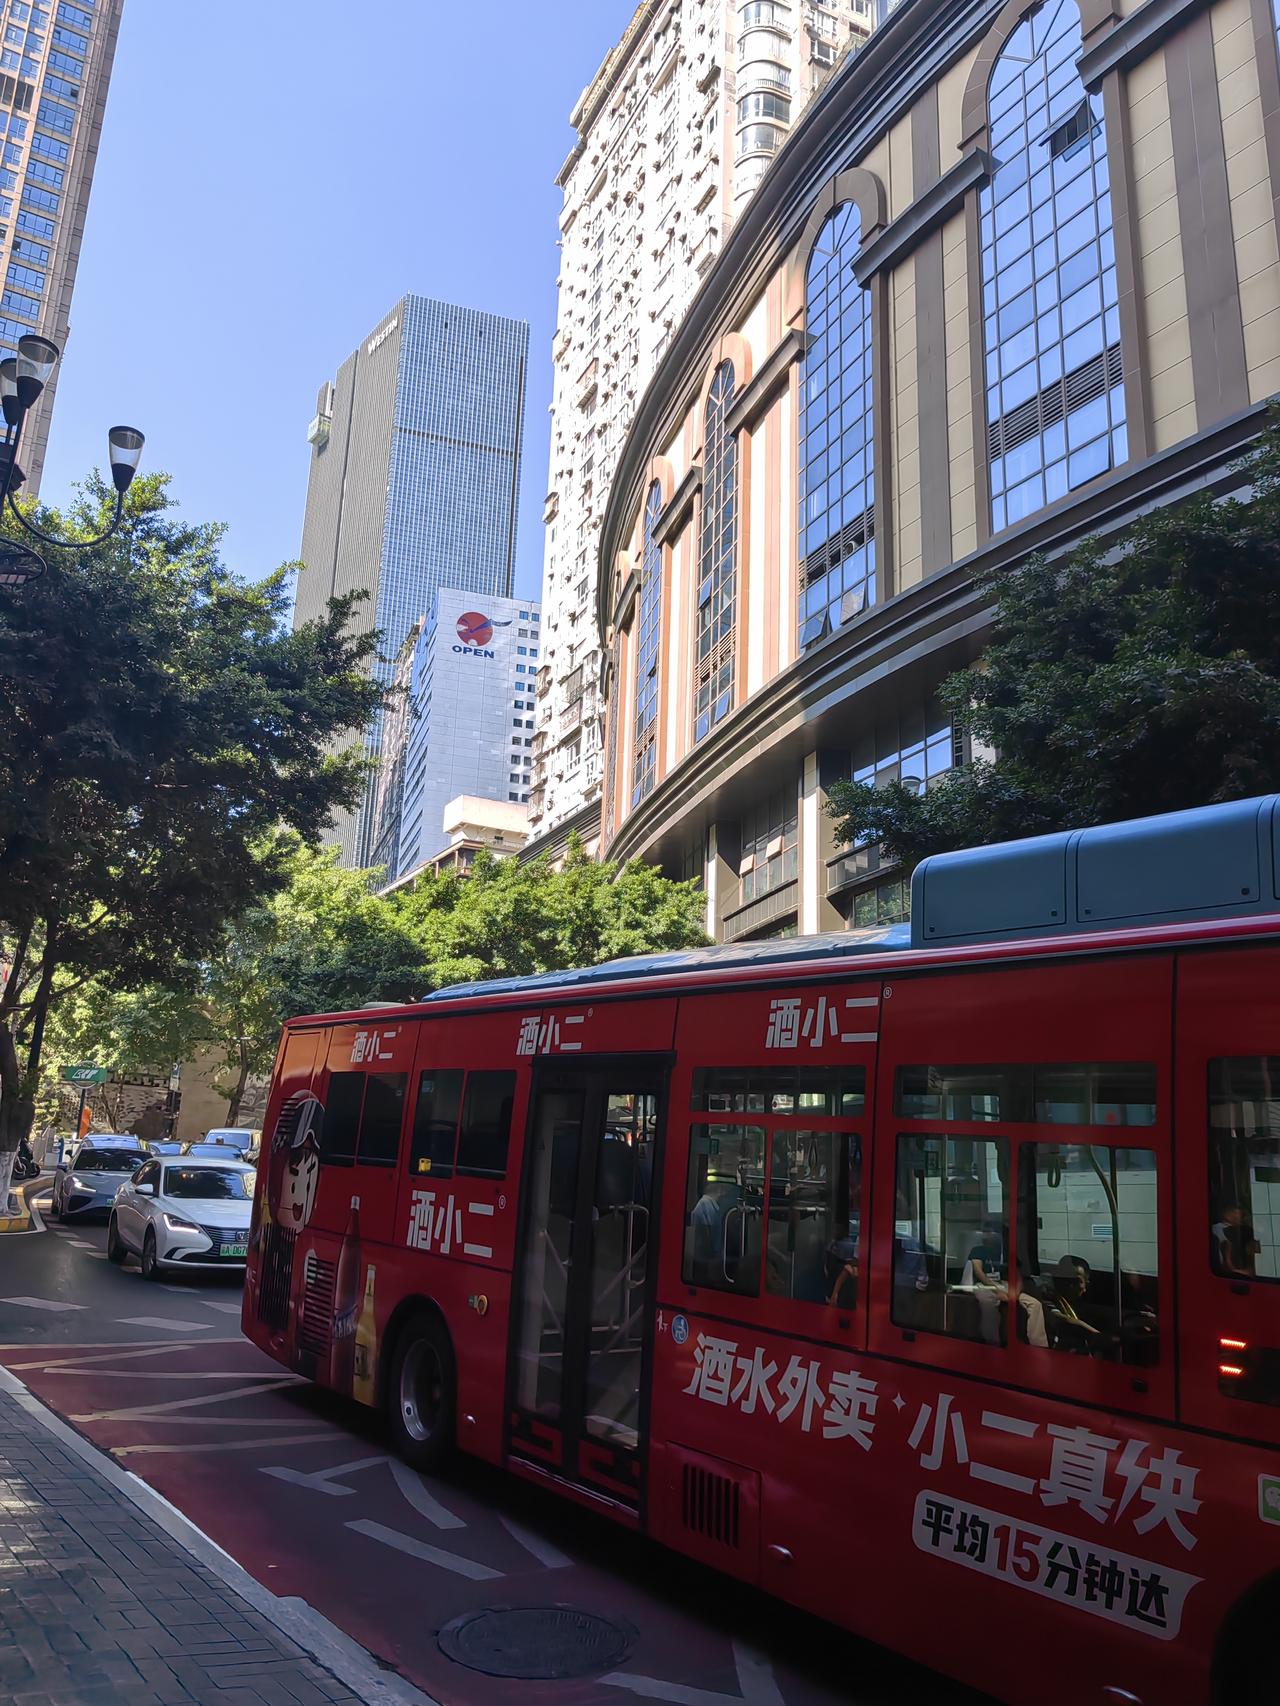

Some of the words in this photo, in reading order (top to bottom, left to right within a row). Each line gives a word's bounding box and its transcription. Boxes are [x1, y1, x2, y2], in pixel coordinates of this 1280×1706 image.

[368, 316, 398, 354] WESTIN
[452, 645, 495, 659] OPEN
[515, 1015, 585, 1056] 酒小二
[765, 996, 879, 1048] 酒小二
[350, 1031, 396, 1063] 酒小二
[406, 1190, 494, 1258] 酒小二
[682, 1332, 879, 1452] 酒水外卖
[907, 1393, 1204, 1552] 小二真快
[921, 1498, 1170, 1629] 平均15分钟达
